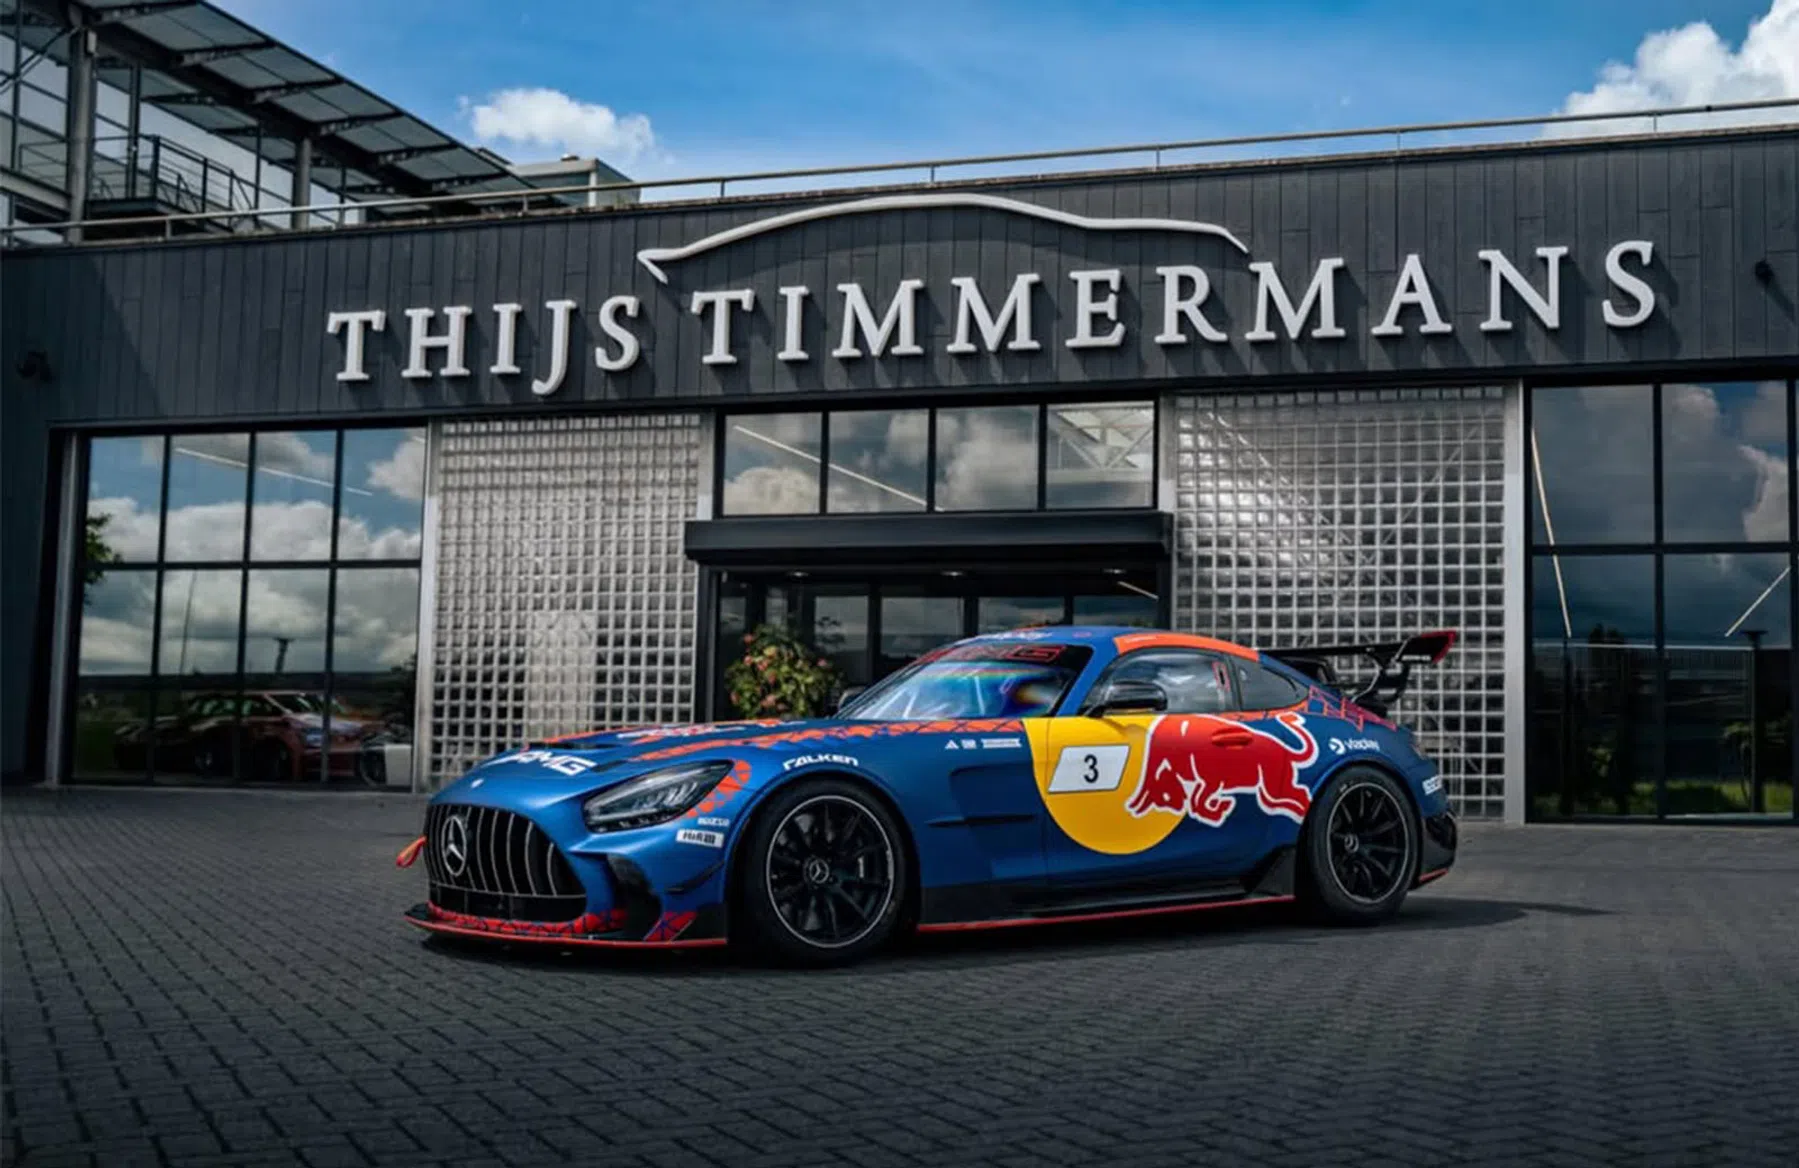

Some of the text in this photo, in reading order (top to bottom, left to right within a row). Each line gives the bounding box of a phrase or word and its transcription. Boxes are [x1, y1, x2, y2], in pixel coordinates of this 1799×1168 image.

[327, 239, 1656, 396] THIJS TIMMERMANS
[783, 753, 859, 771] FALKEN
[1083, 754, 1099, 783] 3
